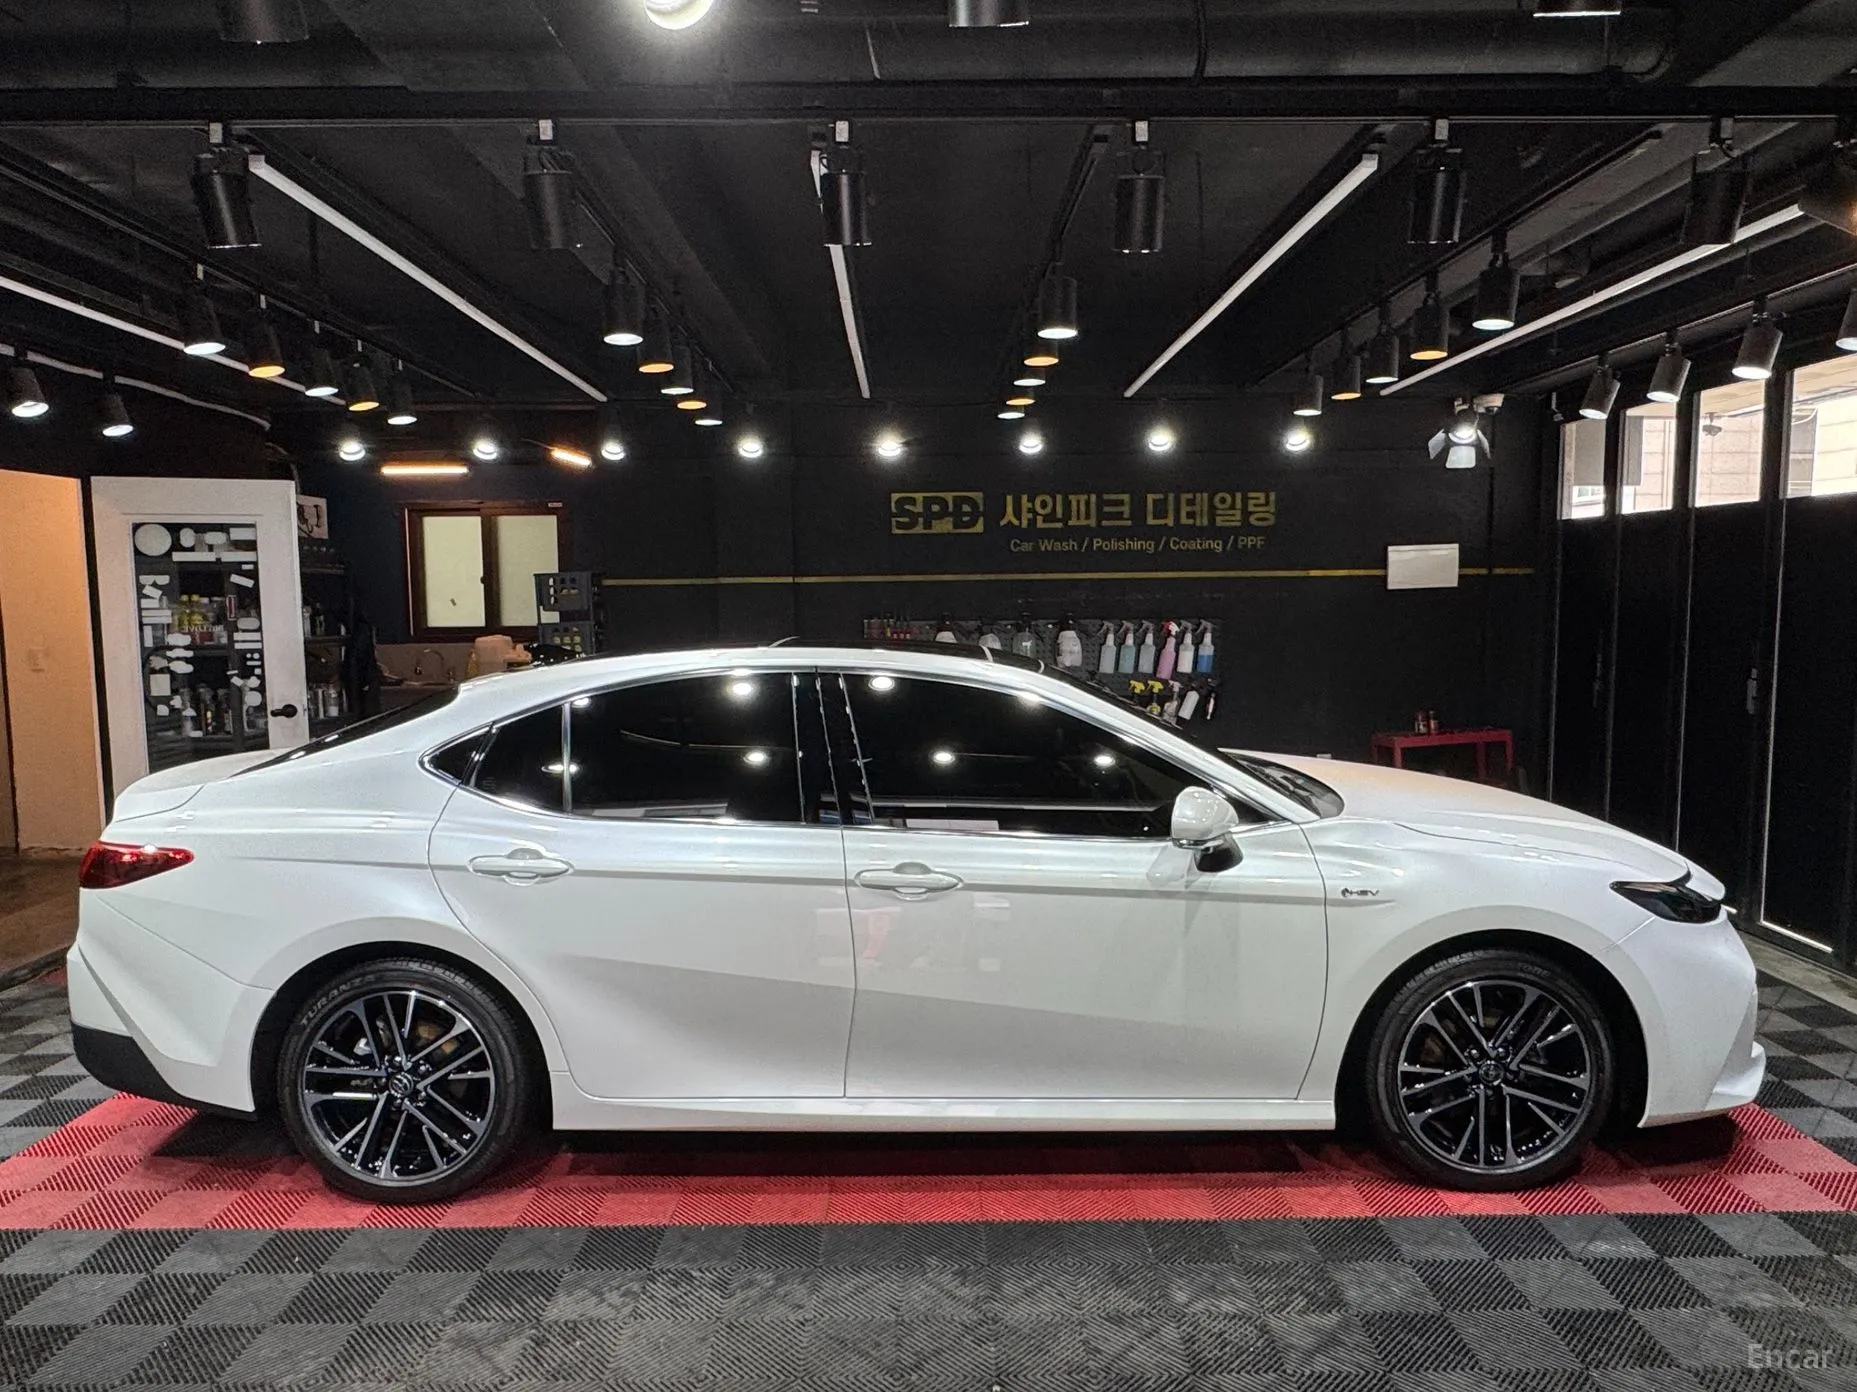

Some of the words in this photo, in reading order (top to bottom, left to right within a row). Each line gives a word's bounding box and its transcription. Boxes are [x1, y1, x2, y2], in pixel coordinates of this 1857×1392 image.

[893, 495, 980, 530] SPD
[999, 493, 1132, 529] 샤인피크
[1145, 491, 1276, 527] 디테일링
[1010, 538, 1036, 552] Car
[1038, 538, 1078, 552] Wash
[1093, 537, 1155, 554] Polishing
[1169, 537, 1223, 552] Coating
[1237, 536, 1266, 549] PPF
